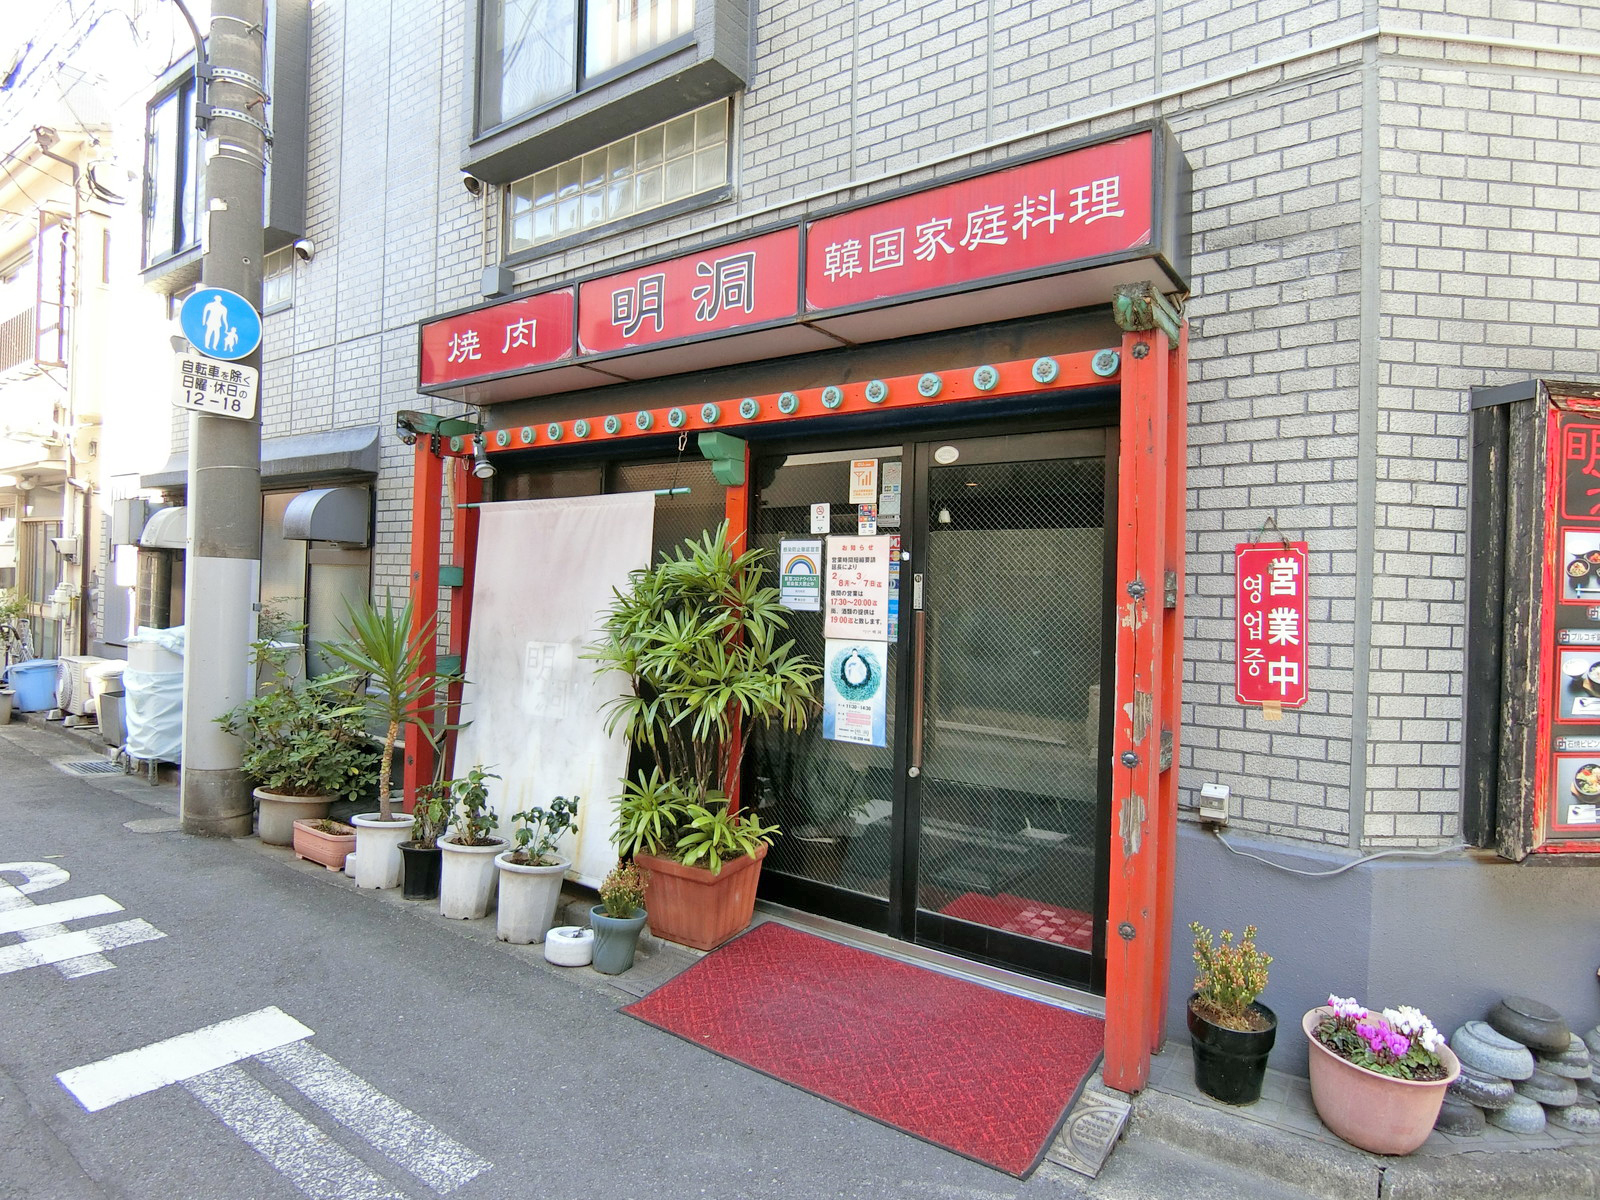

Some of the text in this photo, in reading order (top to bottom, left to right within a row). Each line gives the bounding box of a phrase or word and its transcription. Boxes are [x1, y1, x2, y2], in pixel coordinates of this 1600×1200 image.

[823, 175, 1125, 282] 韓国家庭料理
[447, 317, 537, 363] 焼肉
[611, 251, 756, 338] 明洞
[182, 360, 250, 386] 自転車を除く
[1242, 573, 1266, 677] 영업중
[1267, 556, 1300, 696] 営業中
